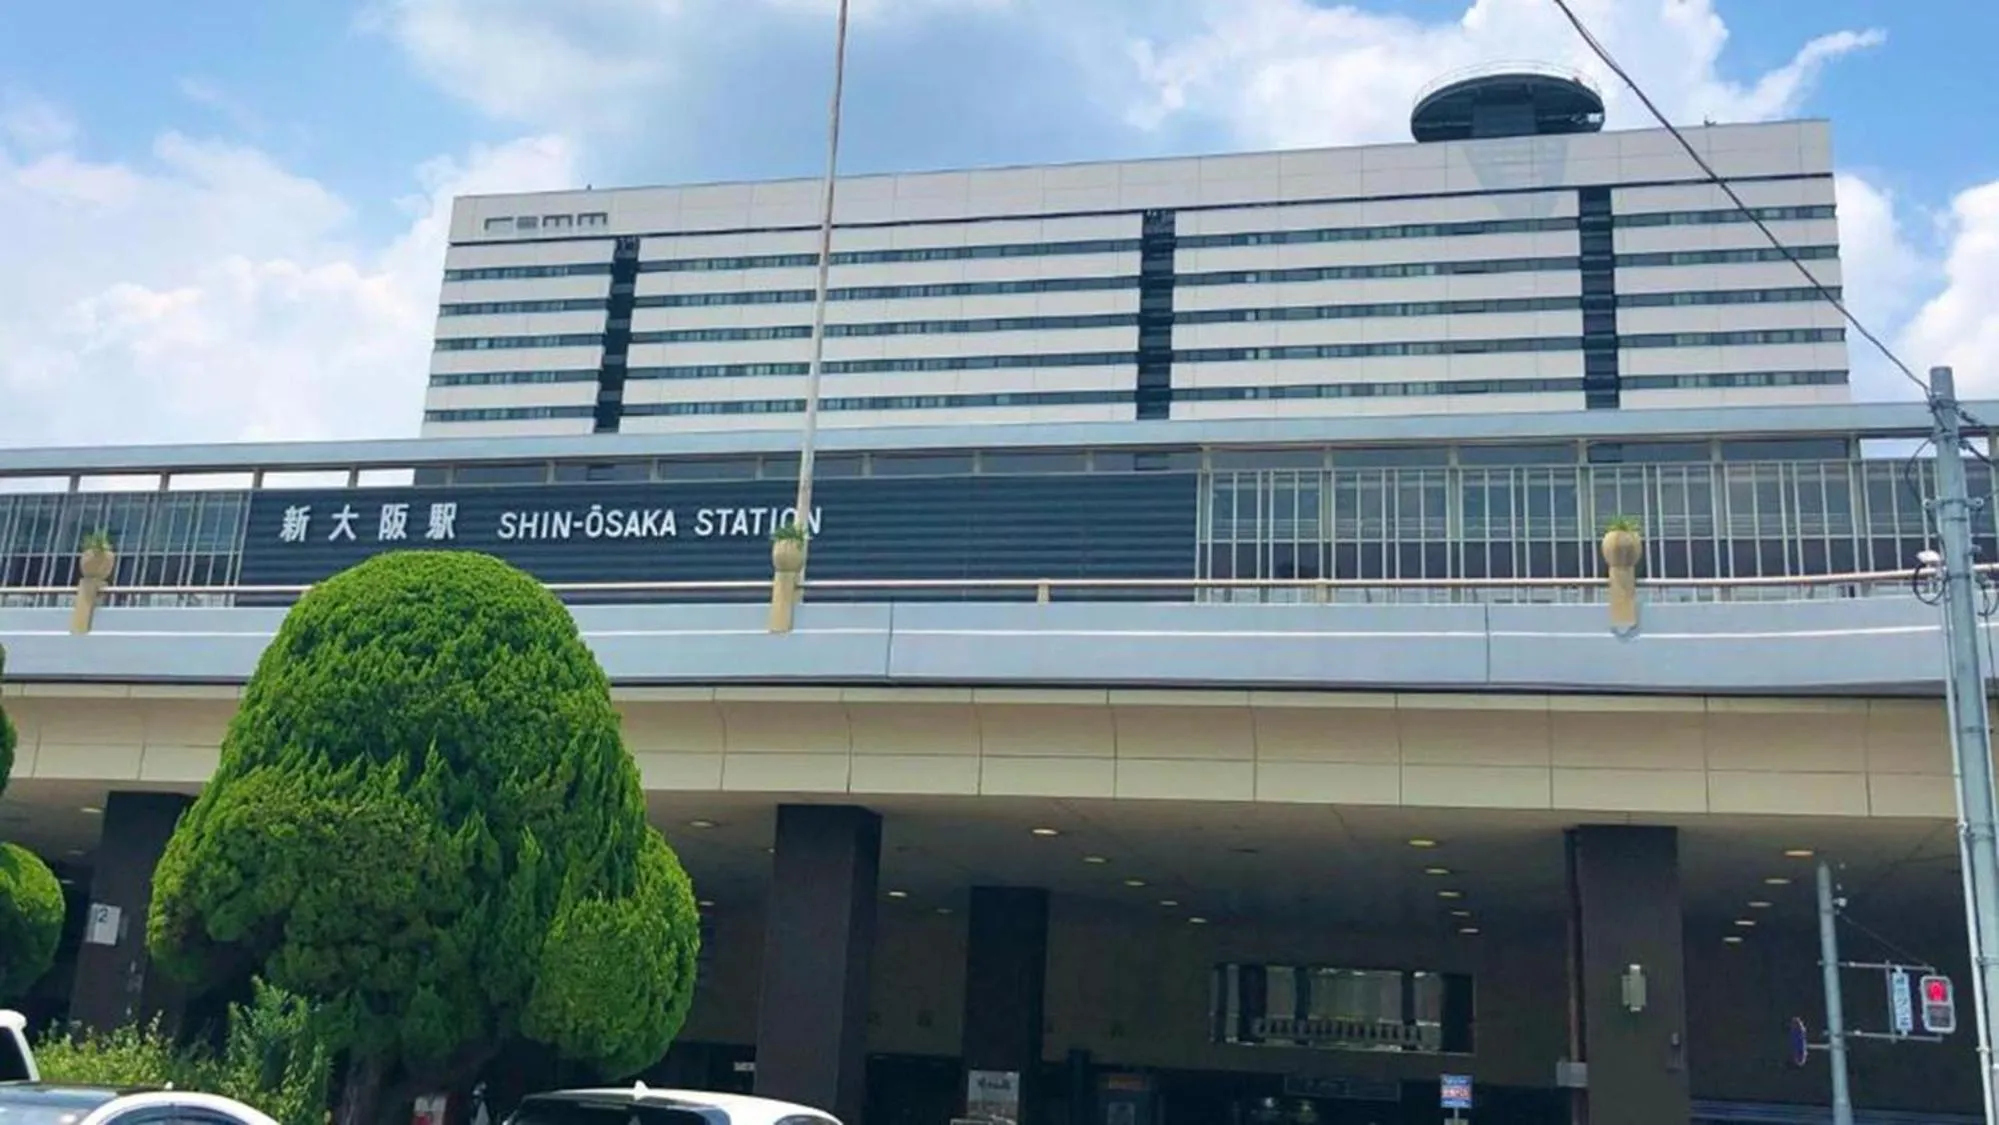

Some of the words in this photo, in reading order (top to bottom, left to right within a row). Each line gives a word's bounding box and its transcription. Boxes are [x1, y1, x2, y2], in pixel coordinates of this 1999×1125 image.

[280, 503, 457, 542] 新大阪駅
[497, 505, 677, 539] SHIN-ŌSAKA
